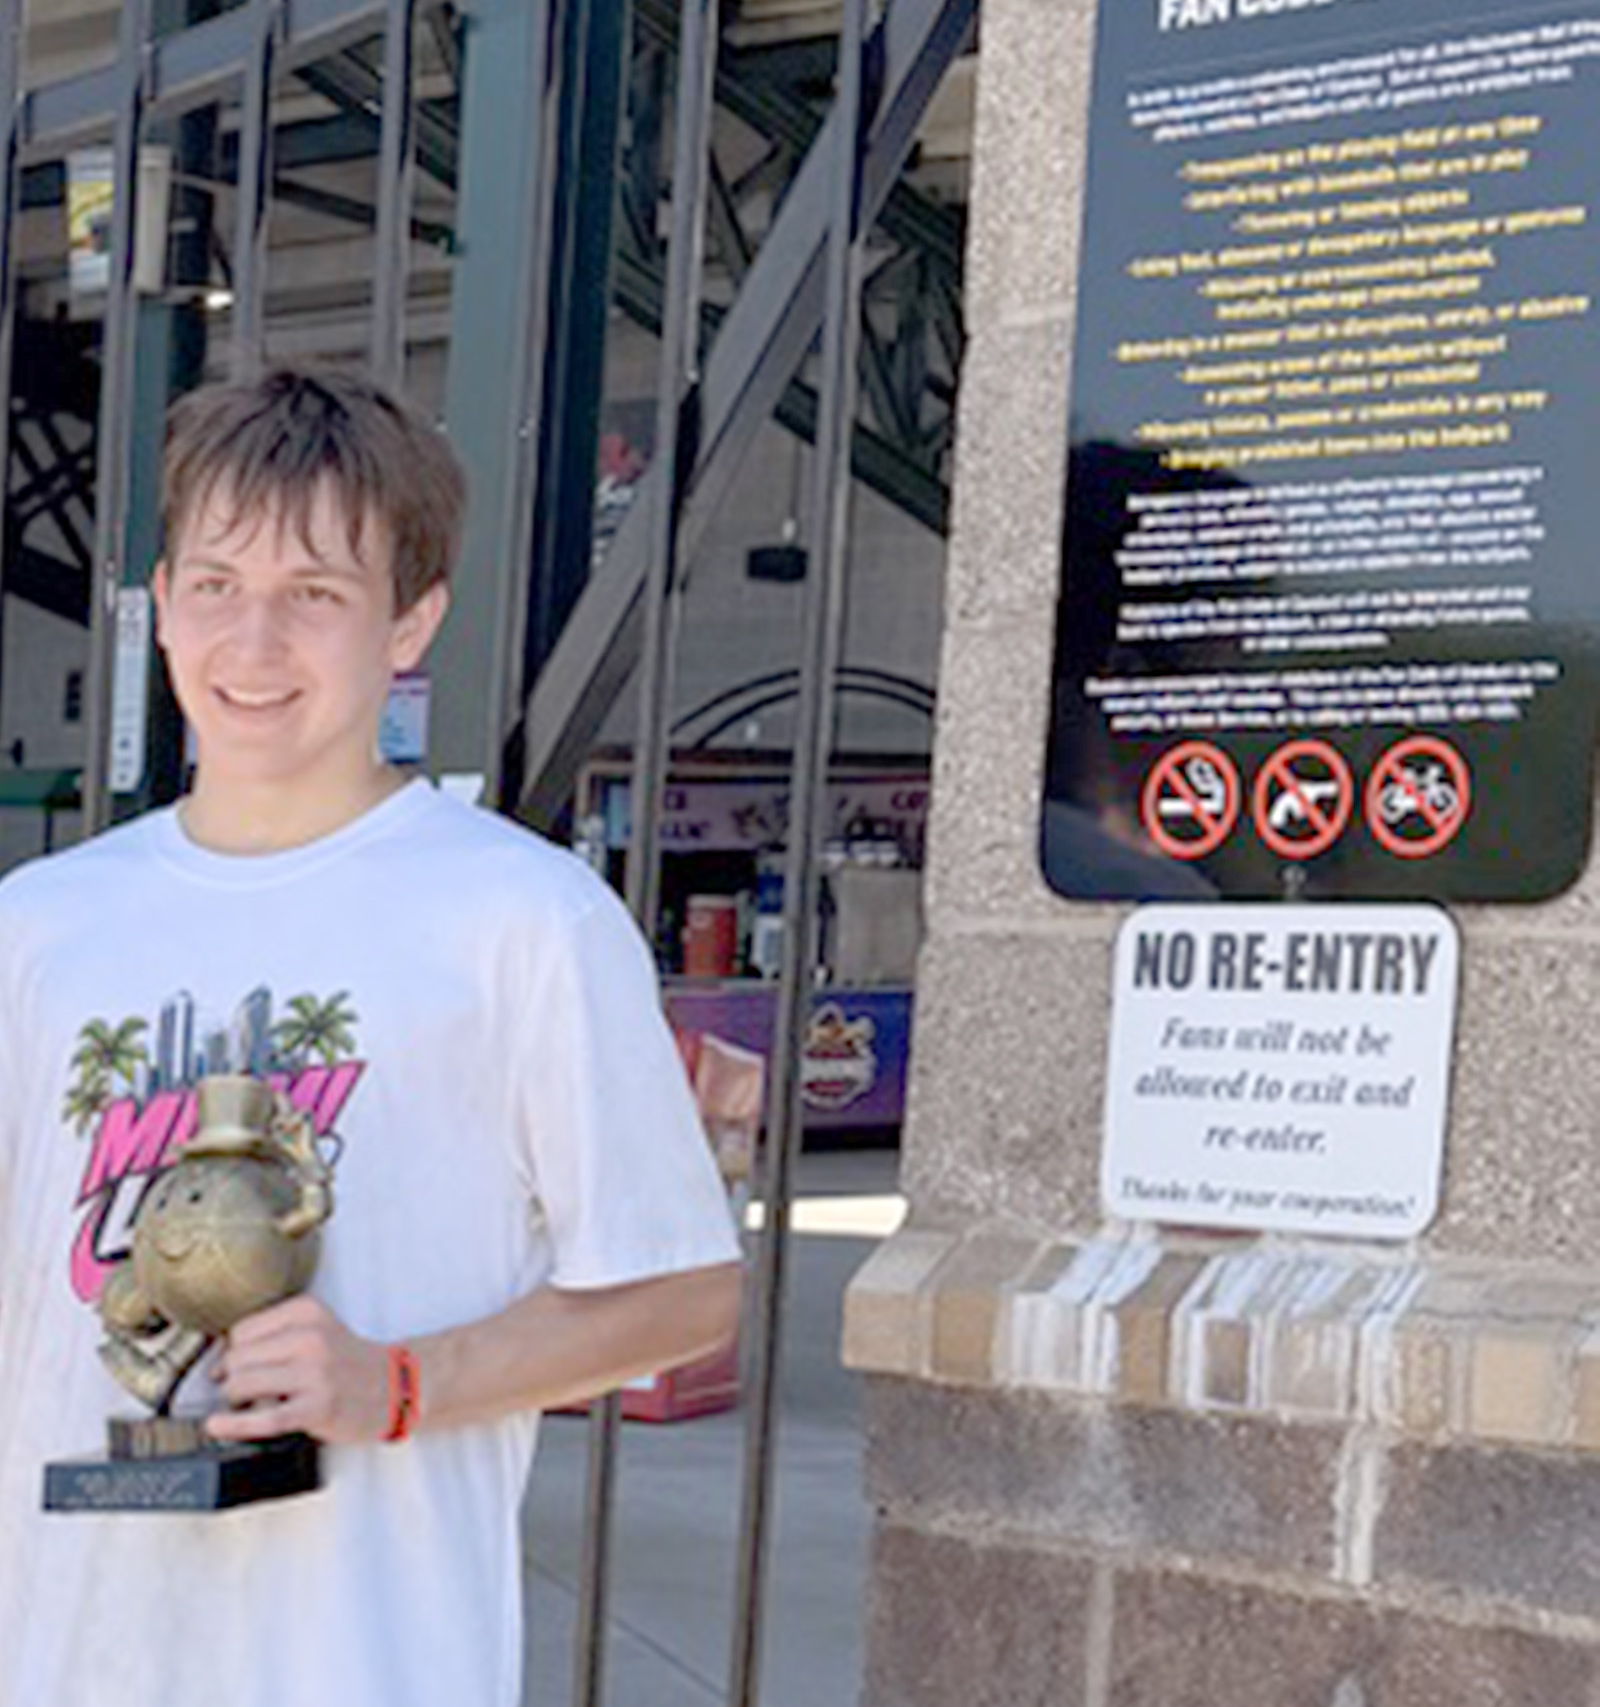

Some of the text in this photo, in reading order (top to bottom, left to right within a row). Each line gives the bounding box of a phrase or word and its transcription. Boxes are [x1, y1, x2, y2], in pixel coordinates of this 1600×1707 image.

[1133, 931, 1438, 995] NO RE-ENTRY
[1160, 1017, 1393, 1057] Fans will not be
[1134, 1067, 1415, 1108] allowed to exit and
[1202, 1124, 1327, 1155] re-enter.
